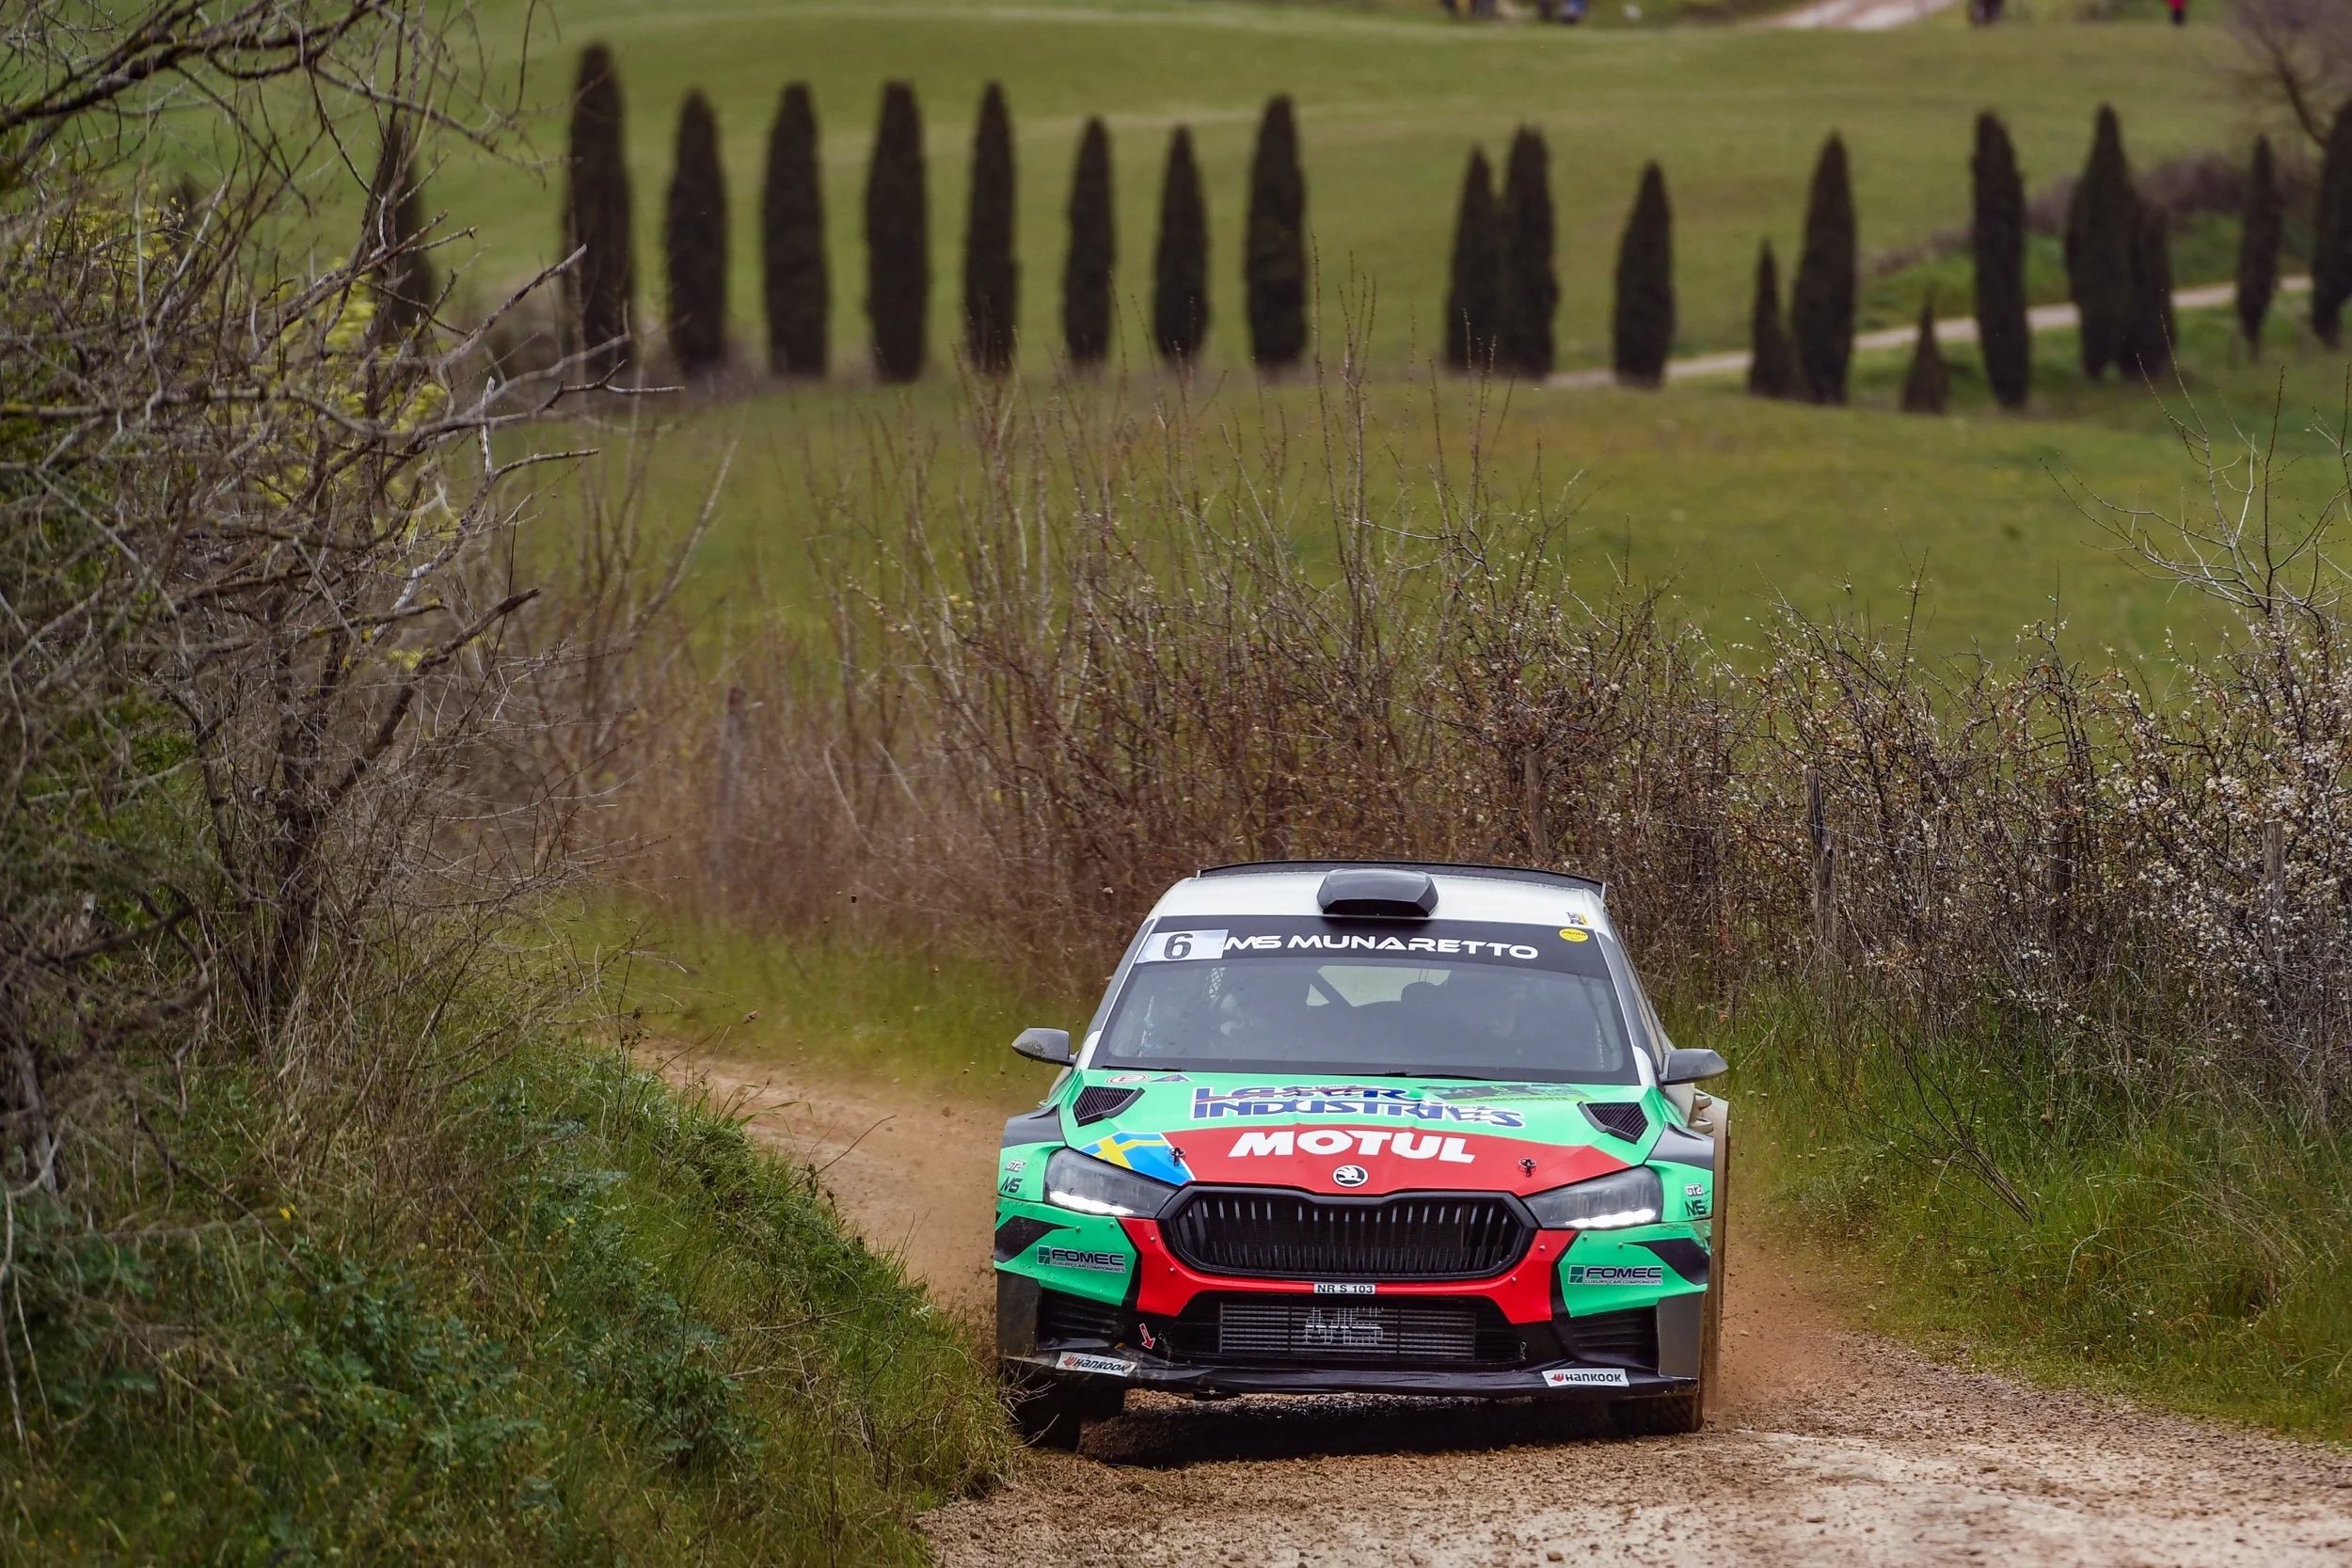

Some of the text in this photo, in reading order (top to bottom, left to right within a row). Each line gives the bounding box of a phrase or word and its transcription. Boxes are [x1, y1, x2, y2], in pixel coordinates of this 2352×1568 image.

[1163, 932, 1194, 959] 6
[1223, 935, 1282, 951] MS
[1286, 934, 1539, 960] MUNARETTO
[1194, 1085, 1424, 1104] LASER
[1192, 1099, 1525, 1129] INDUSTRIES
[1227, 1129, 1476, 1164] MOTUL
[1051, 1248, 1124, 1266] FOMEC
[1585, 1267, 1662, 1278] FOMEC
[1317, 1284, 1373, 1293] NR S 103
